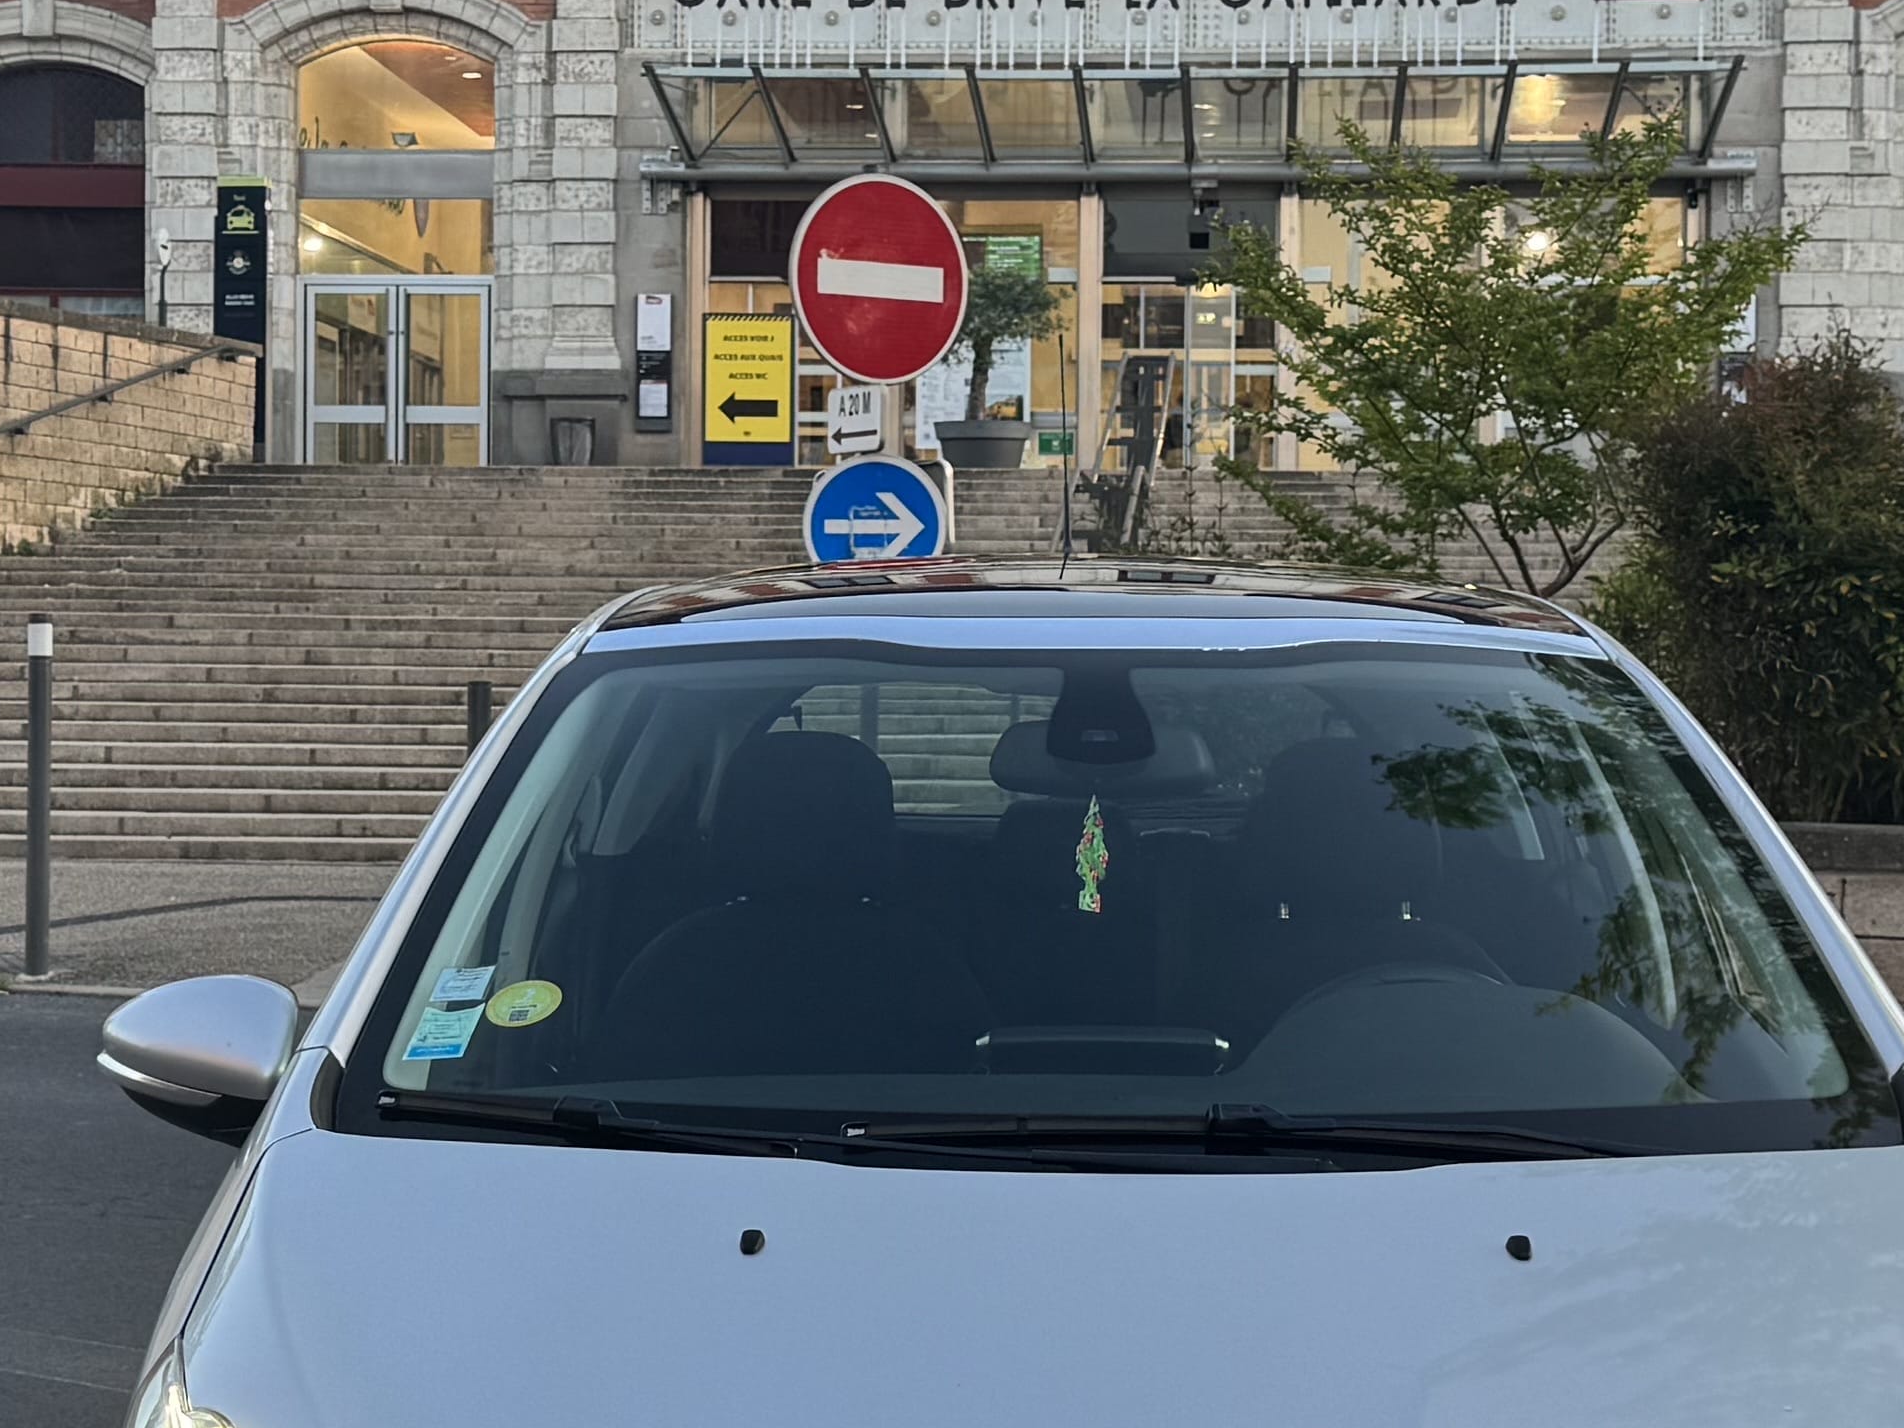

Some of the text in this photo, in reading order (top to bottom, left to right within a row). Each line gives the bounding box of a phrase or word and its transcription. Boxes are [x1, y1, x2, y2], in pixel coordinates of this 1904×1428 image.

[838, 391, 872, 417] A 20 M
